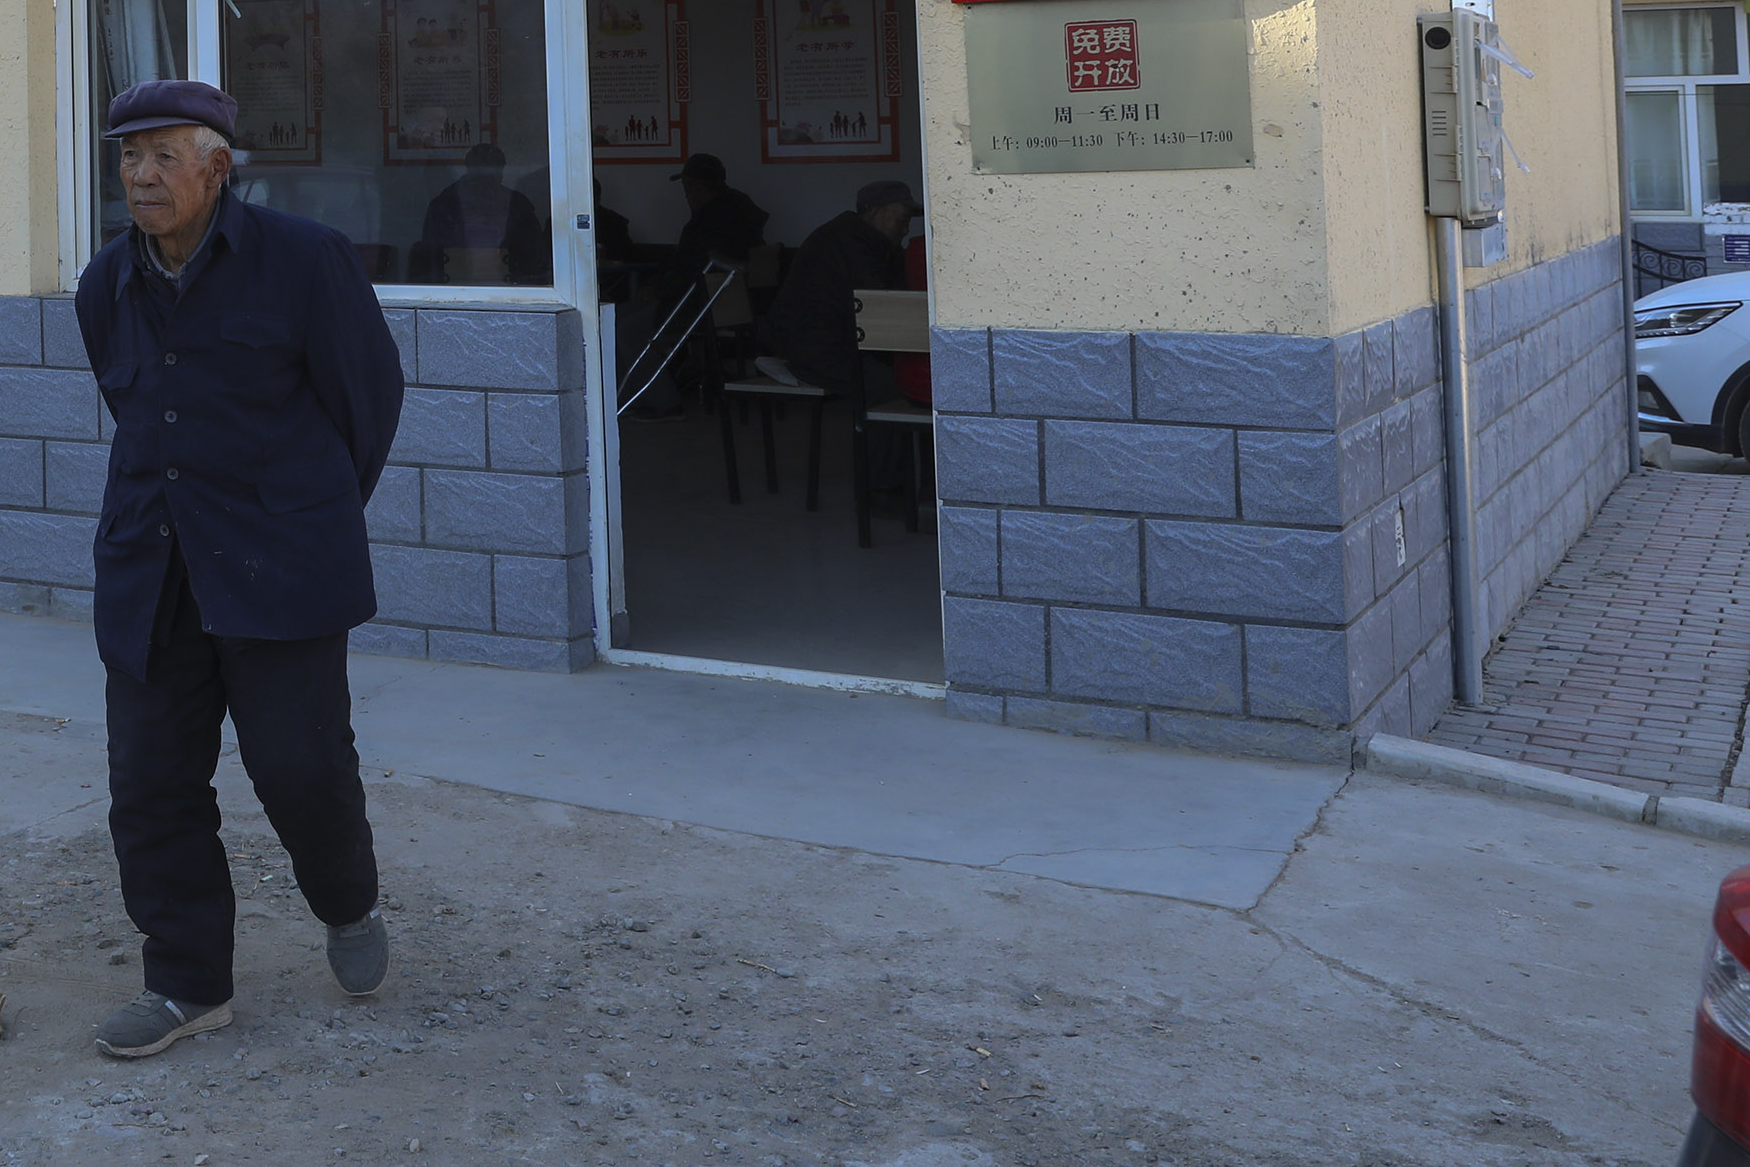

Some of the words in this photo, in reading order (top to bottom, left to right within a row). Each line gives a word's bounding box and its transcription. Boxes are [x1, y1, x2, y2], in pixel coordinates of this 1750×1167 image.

[795, 40, 856, 53] 老有所学
[1071, 26, 1132, 55] 免费
[1073, 58, 1134, 87] 开放
[1054, 103, 1160, 124] 周一至周日
